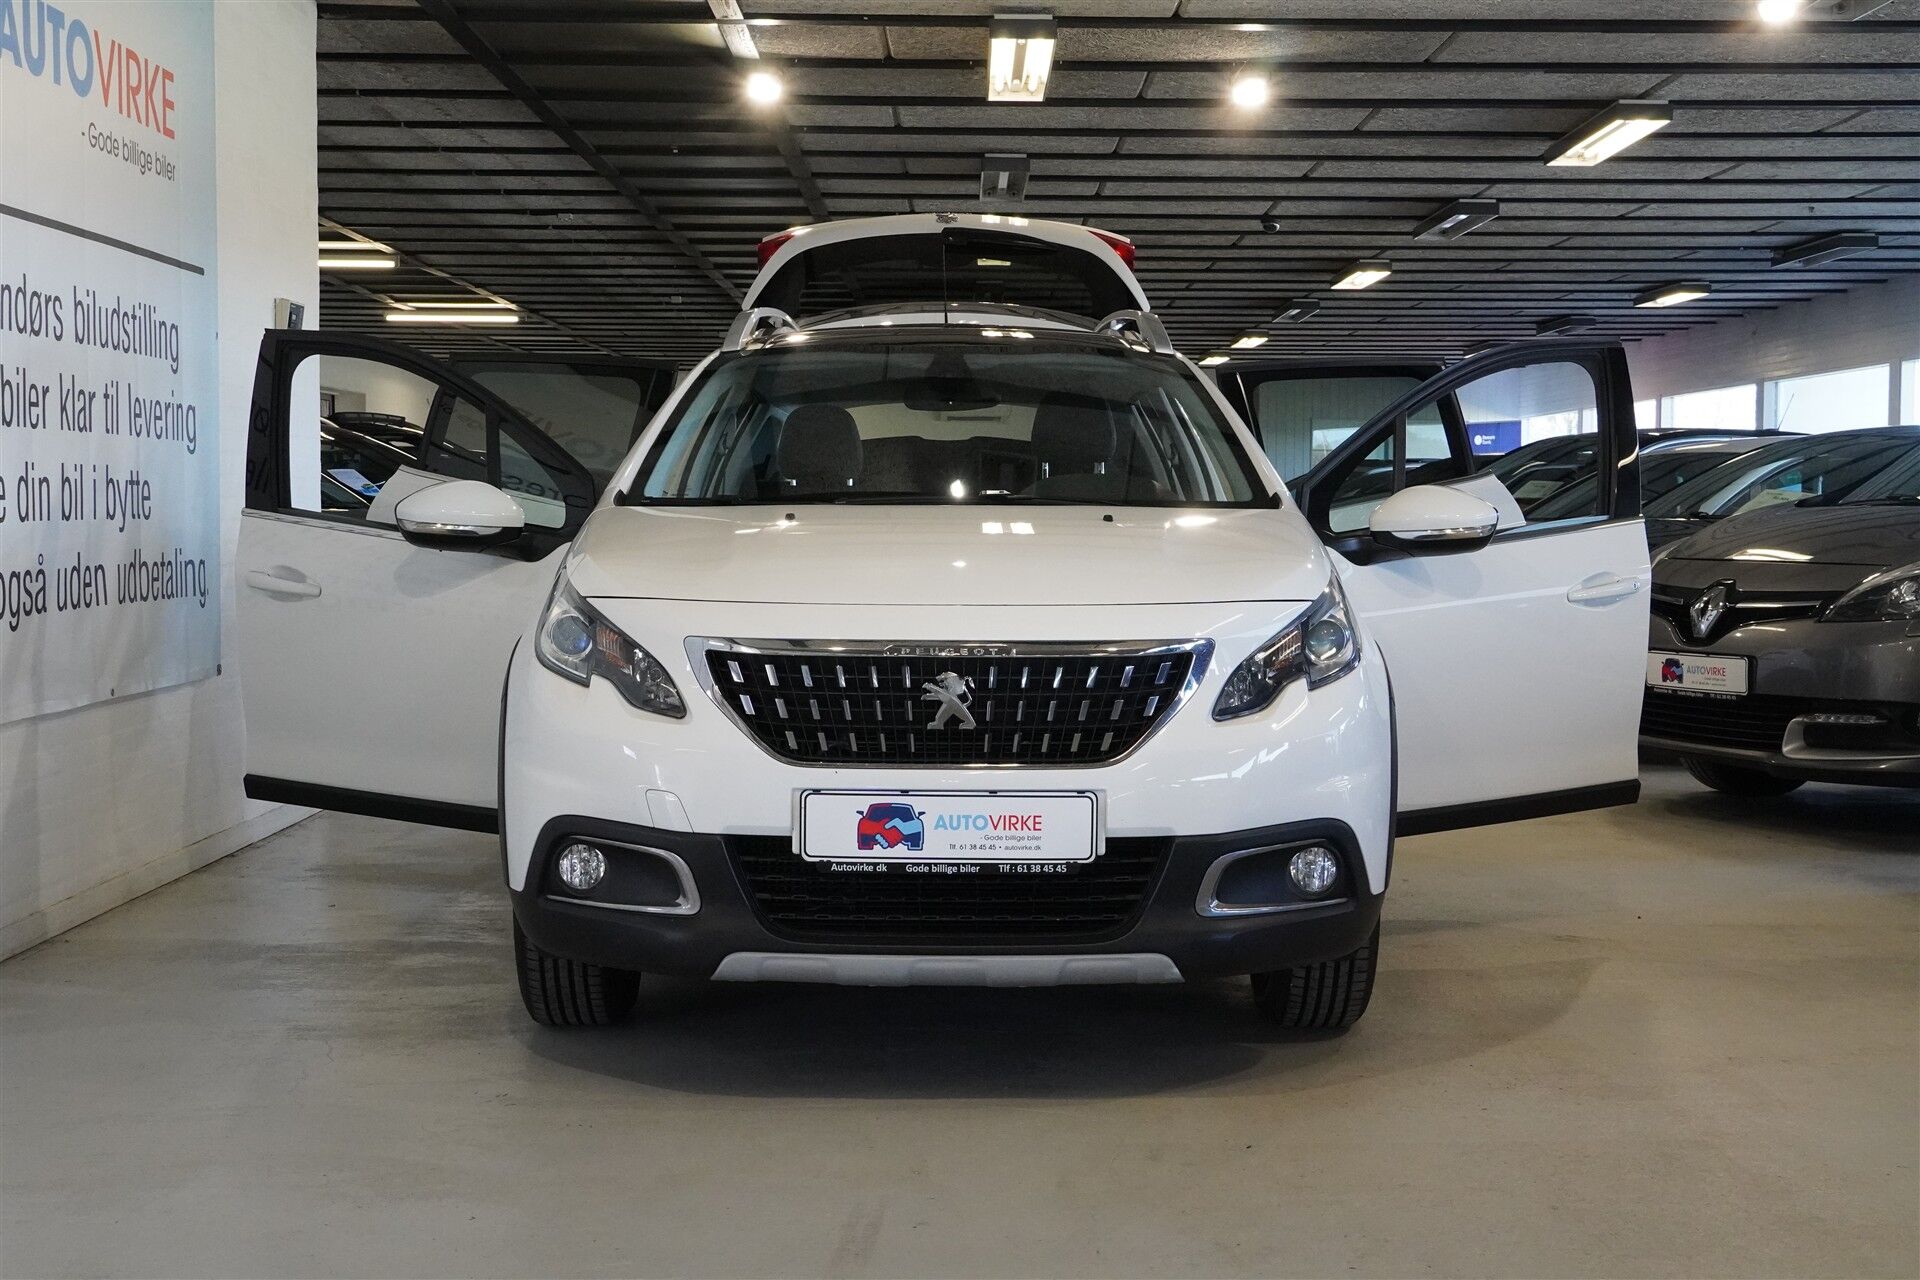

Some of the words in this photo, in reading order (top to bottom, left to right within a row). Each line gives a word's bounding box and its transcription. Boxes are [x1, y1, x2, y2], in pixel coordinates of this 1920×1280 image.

[0, 0, 175, 140] AUTOVIRKE
[88, 121, 120, 158] Gode
[122, 136, 153, 175] billige
[155, 151, 176, 182] biler
[1, 272, 64, 341] ndørs
[73, 285, 179, 375] biludstilling
[0, 364, 50, 430] biler
[59, 372, 96, 434] klar
[103, 380, 119, 435] til
[128, 382, 196, 455] levering
[17, 460, 51, 523] din
[61, 462, 84, 522] bil
[92, 464, 97, 520] i
[105, 464, 152, 533] bytte
[56, 551, 108, 612] uden
[1686, 665, 1726, 677] AUTOVIRKE
[934, 814, 1042, 831] AUTOVIRKE
[959, 843, 967, 851] 61
[1005, 834, 1026, 842] billige
[830, 863, 874, 872] Autovirke
[876, 863, 888, 873] dk
[905, 864, 929, 873] Gode
[931, 863, 958, 875] billige
[960, 864, 981, 873] biler
[1017, 864, 1028, 873] 61
[1030, 864, 1041, 873] 38
[1042, 864, 1054, 873] 45
[1055, 864, 1067, 873] 45
